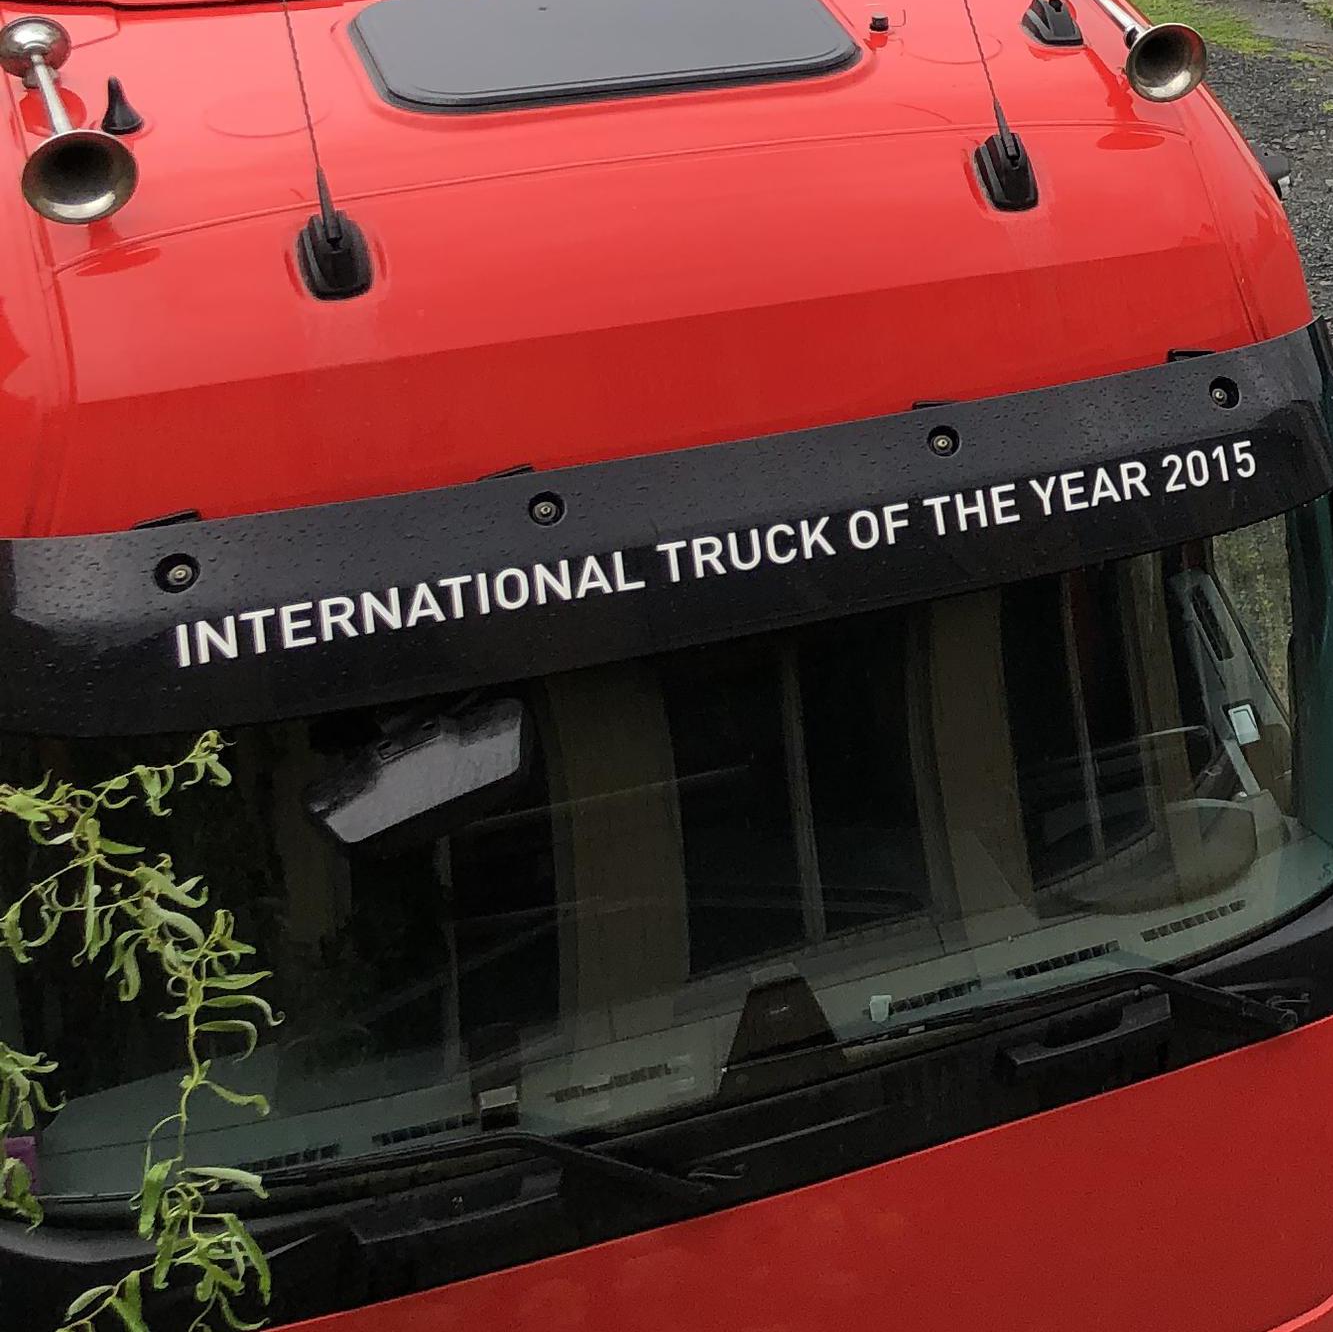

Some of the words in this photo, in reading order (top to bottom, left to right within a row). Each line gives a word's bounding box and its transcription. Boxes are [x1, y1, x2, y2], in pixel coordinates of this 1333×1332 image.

[175, 551, 647, 668] INTERNATIONAL
[656, 516, 836, 582] TRUCK
[848, 504, 911, 550] OF
[923, 483, 1021, 536] THE
[1029, 462, 1152, 516] YEAR
[1160, 440, 1256, 494] 2015
